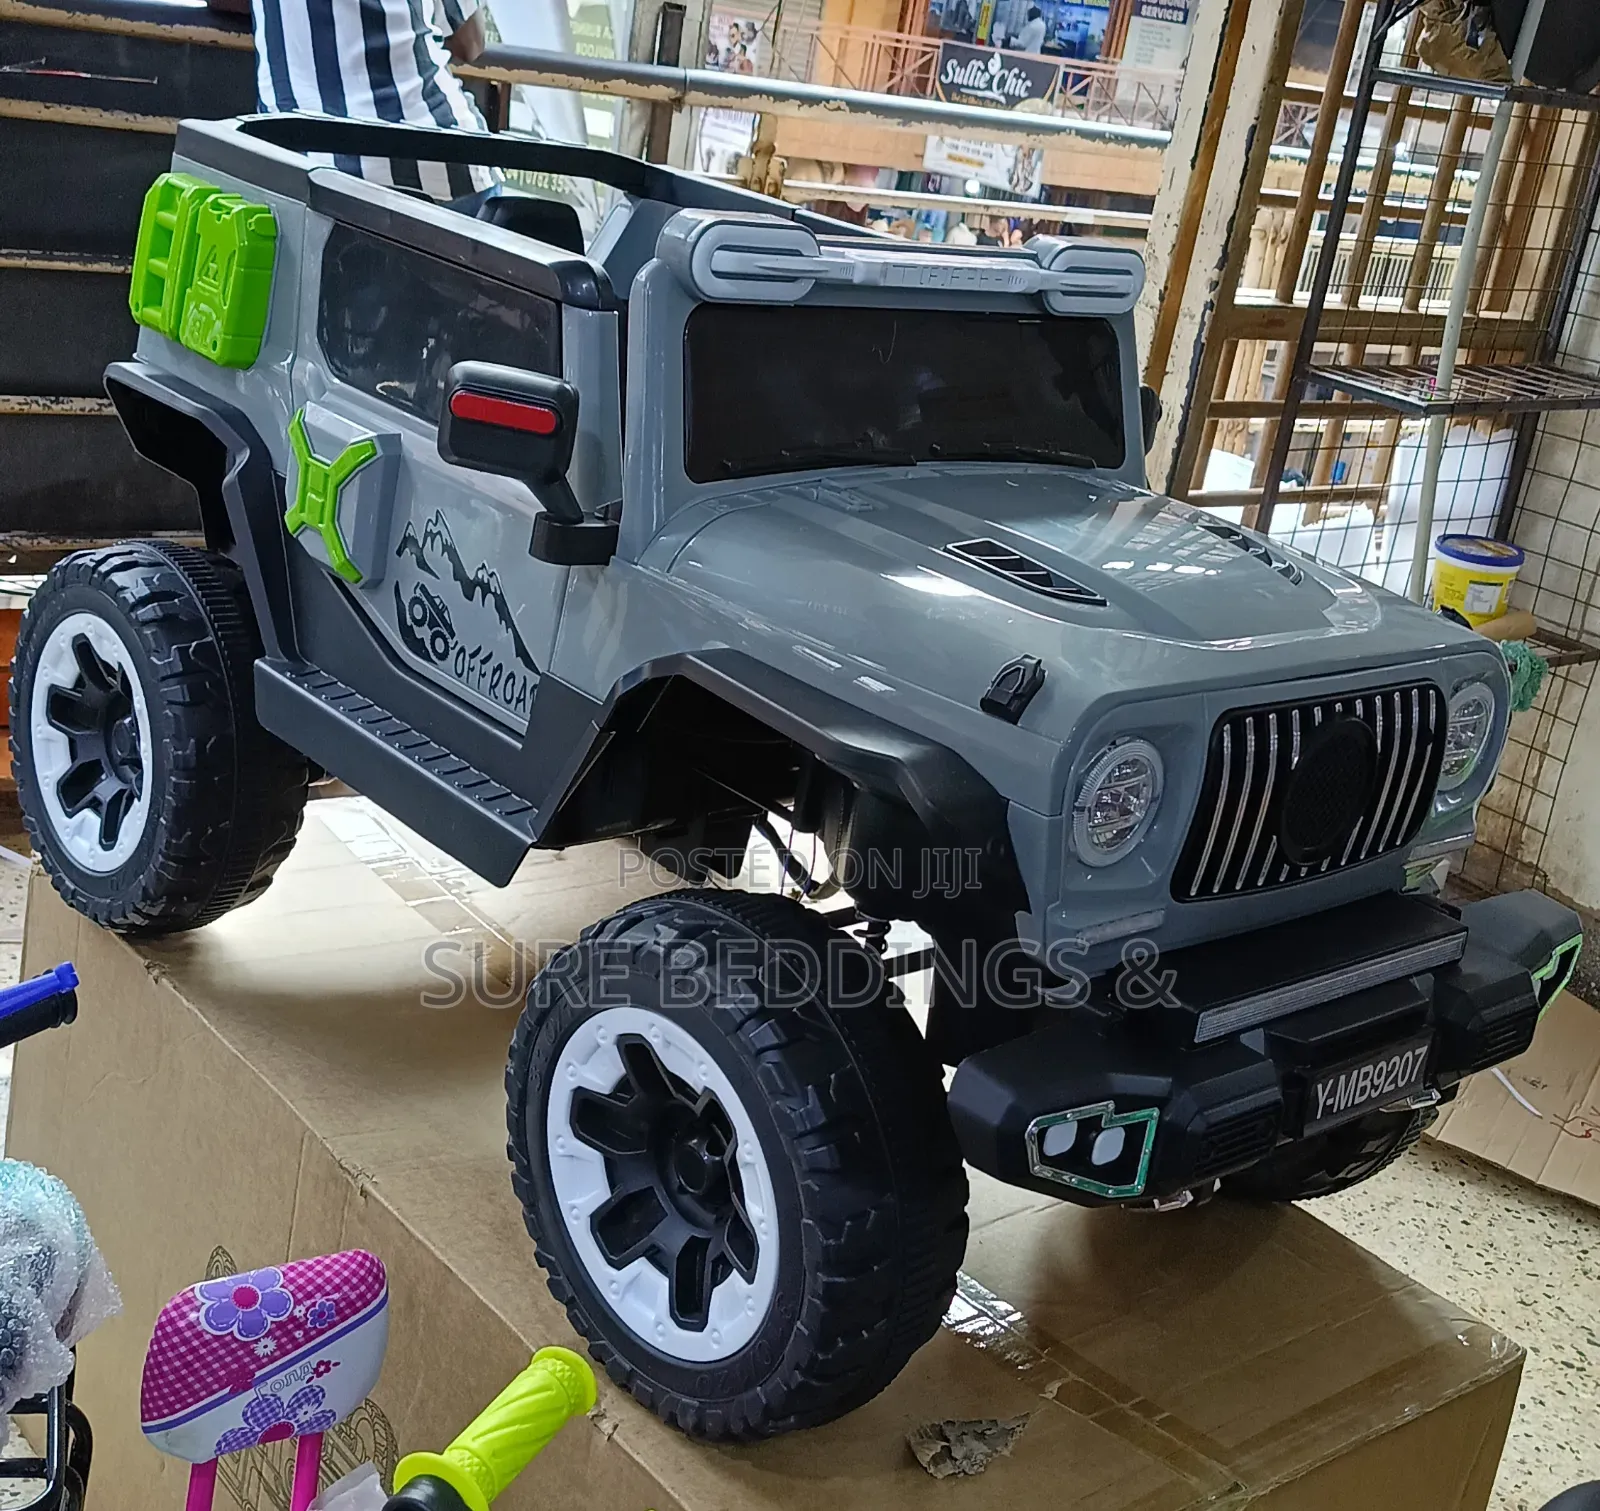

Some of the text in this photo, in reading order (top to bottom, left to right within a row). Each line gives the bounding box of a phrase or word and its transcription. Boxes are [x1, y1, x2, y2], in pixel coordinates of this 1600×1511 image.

[1140, 5, 1184, 22] SERVICES
[992, 67, 1033, 99] Chic
[1316, 1045, 1429, 1120] Y-MB9207
